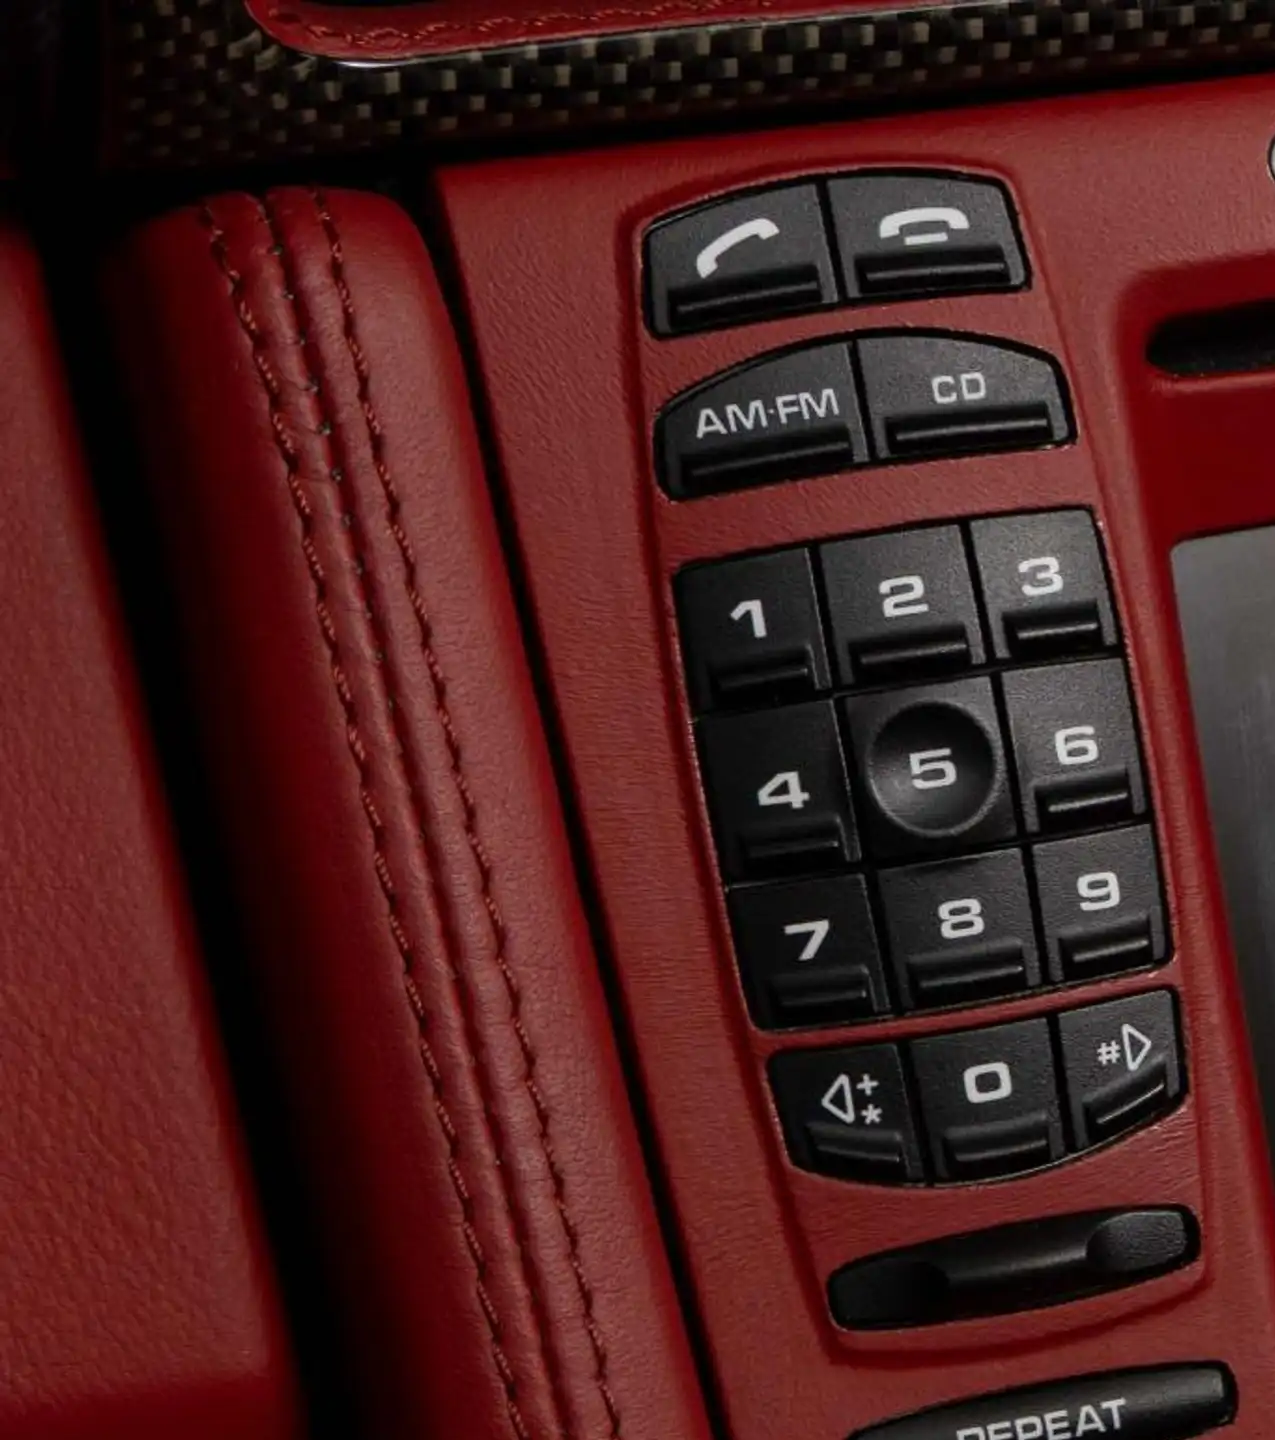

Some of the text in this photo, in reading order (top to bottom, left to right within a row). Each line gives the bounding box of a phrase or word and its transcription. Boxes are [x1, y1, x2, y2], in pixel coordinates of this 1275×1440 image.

[931, 371, 987, 404] CD
[879, 575, 929, 617] 2
[1018, 556, 1064, 596] 3
[730, 599, 767, 638] 1
[1054, 725, 1098, 765] 6
[908, 749, 957, 790] 5
[757, 771, 810, 809] 4
[1077, 871, 1120, 911] 9
[938, 898, 985, 939] 8
[784, 919, 830, 960] 7
[963, 1061, 1012, 1103] 0
